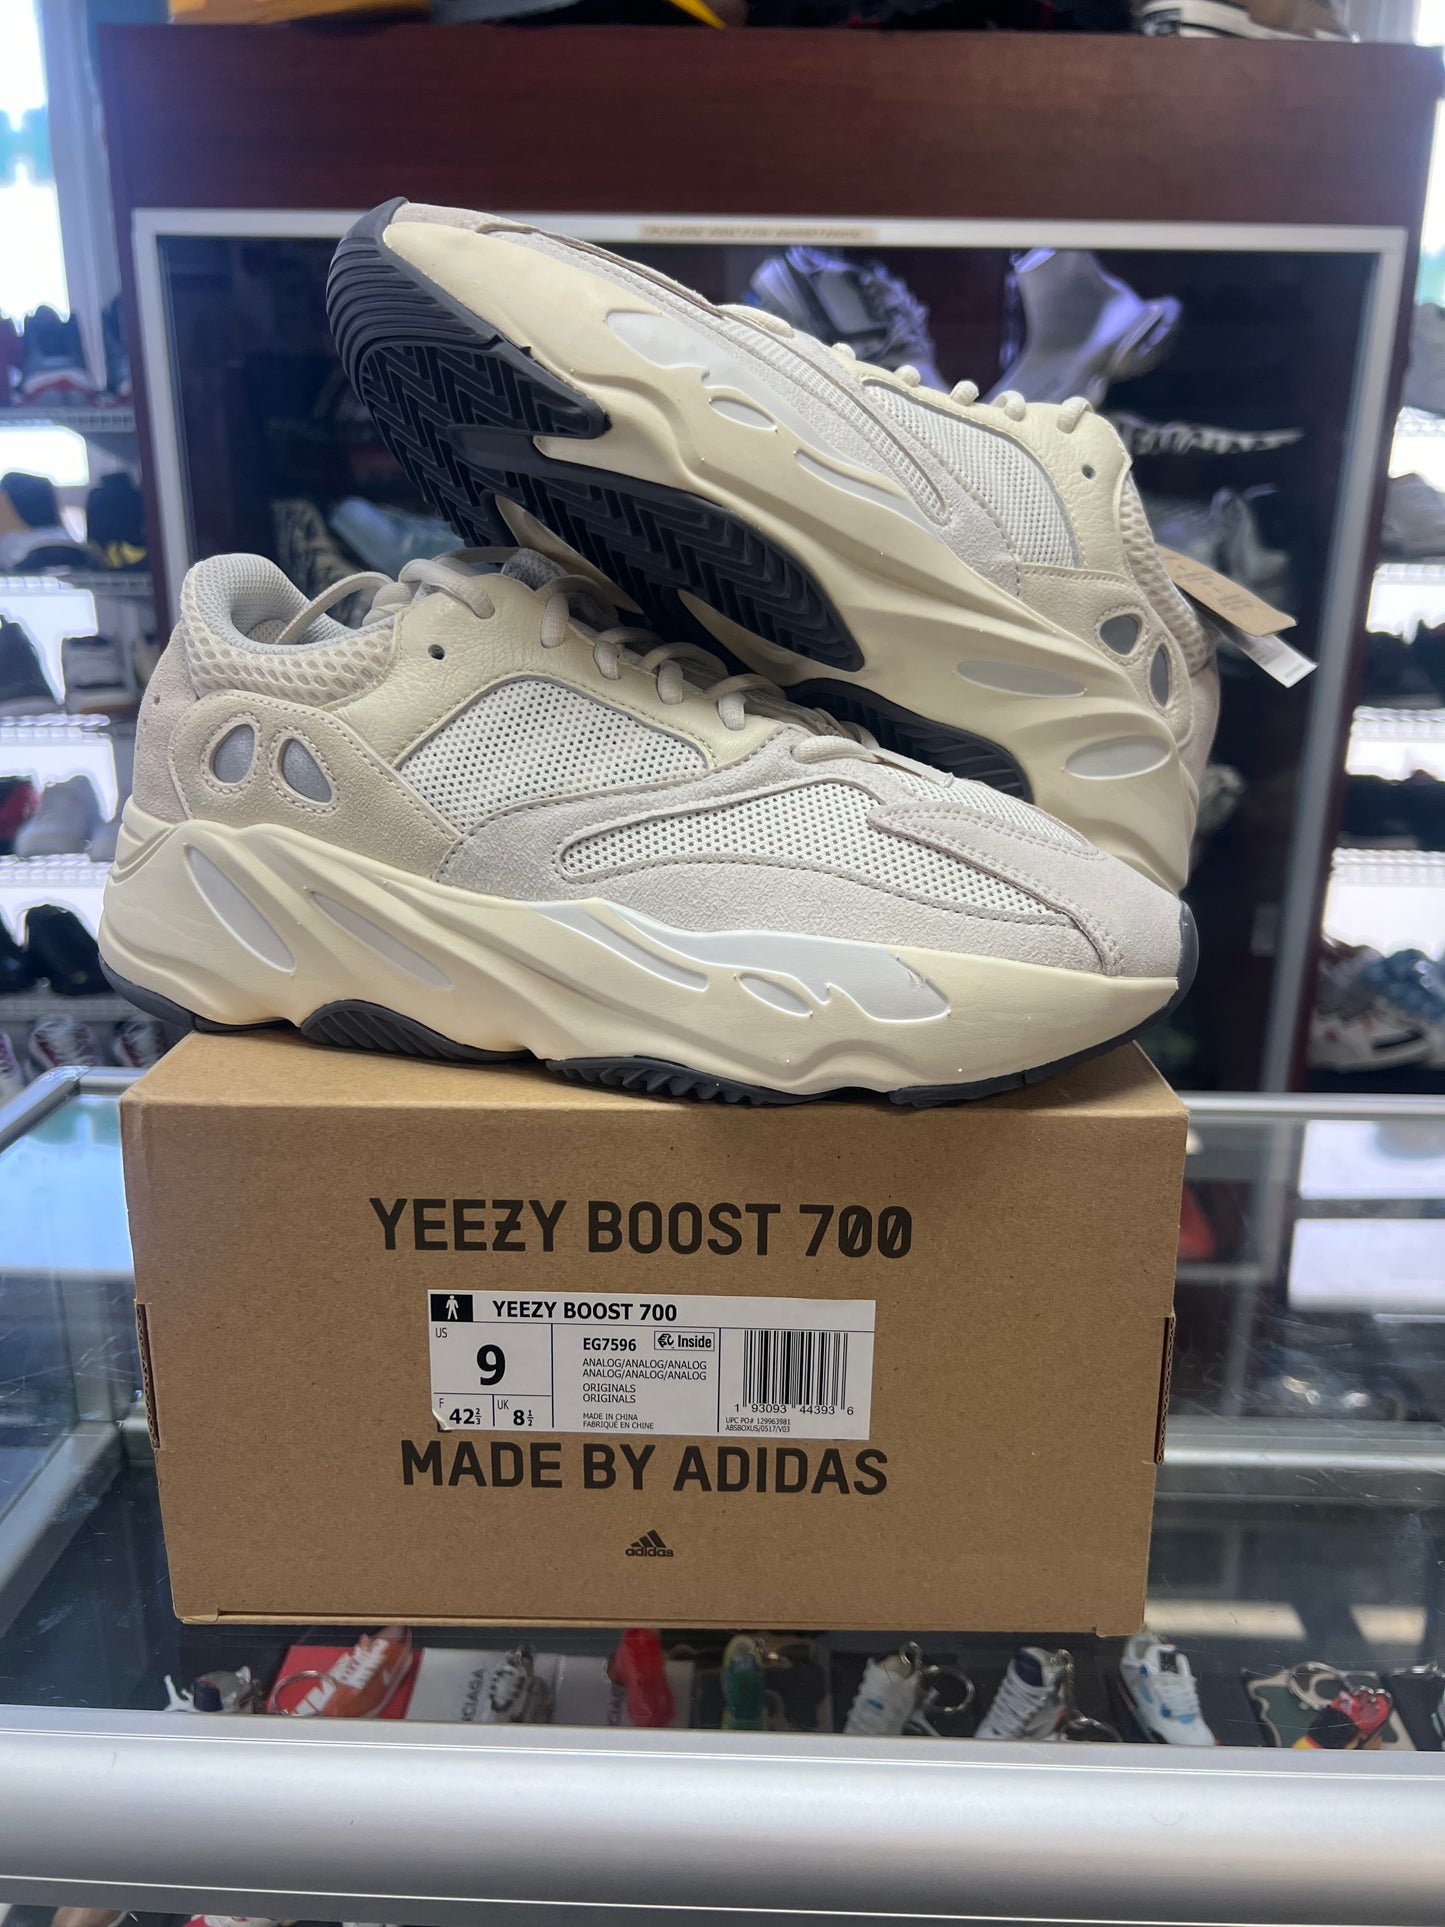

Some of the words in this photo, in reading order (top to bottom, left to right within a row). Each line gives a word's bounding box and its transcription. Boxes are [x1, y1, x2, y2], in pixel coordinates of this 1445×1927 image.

[369, 1198, 567, 1252] YEEZY
[589, 1201, 781, 1255] BOOST
[799, 1203, 912, 1258] 700
[492, 1301, 557, 1318] YEEZY
[564, 1302, 633, 1320] BOOST
[640, 1304, 676, 1321] 700
[435, 1328, 448, 1339] US
[584, 1338, 636, 1351] EG7596
[678, 1335, 711, 1348] Inside
[477, 1345, 505, 1385] 9
[583, 1358, 706, 1371] ANALOG/ANALOG/ANALOG
[583, 1369, 706, 1381] ANALOG/ANALOG/ANALOG
[583, 1383, 635, 1393] ORIGINALS
[439, 1397, 445, 1409] F
[498, 1400, 510, 1410] UK
[583, 1394, 636, 1404] ORIGINALS
[751, 1403, 787, 1413] 93093
[799, 1405, 836, 1415] 44393
[847, 1406, 854, 1416] 6
[583, 1412, 603, 1420] MADE
[725, 1416, 738, 1424] UPC
[620, 1421, 630, 1429] EN
[631, 1421, 654, 1429] CHINE
[401, 1440, 562, 1488] MADE
[583, 1444, 655, 1490] BY
[673, 1446, 887, 1495] ADIDAS
[625, 1547, 674, 1557] adidas
